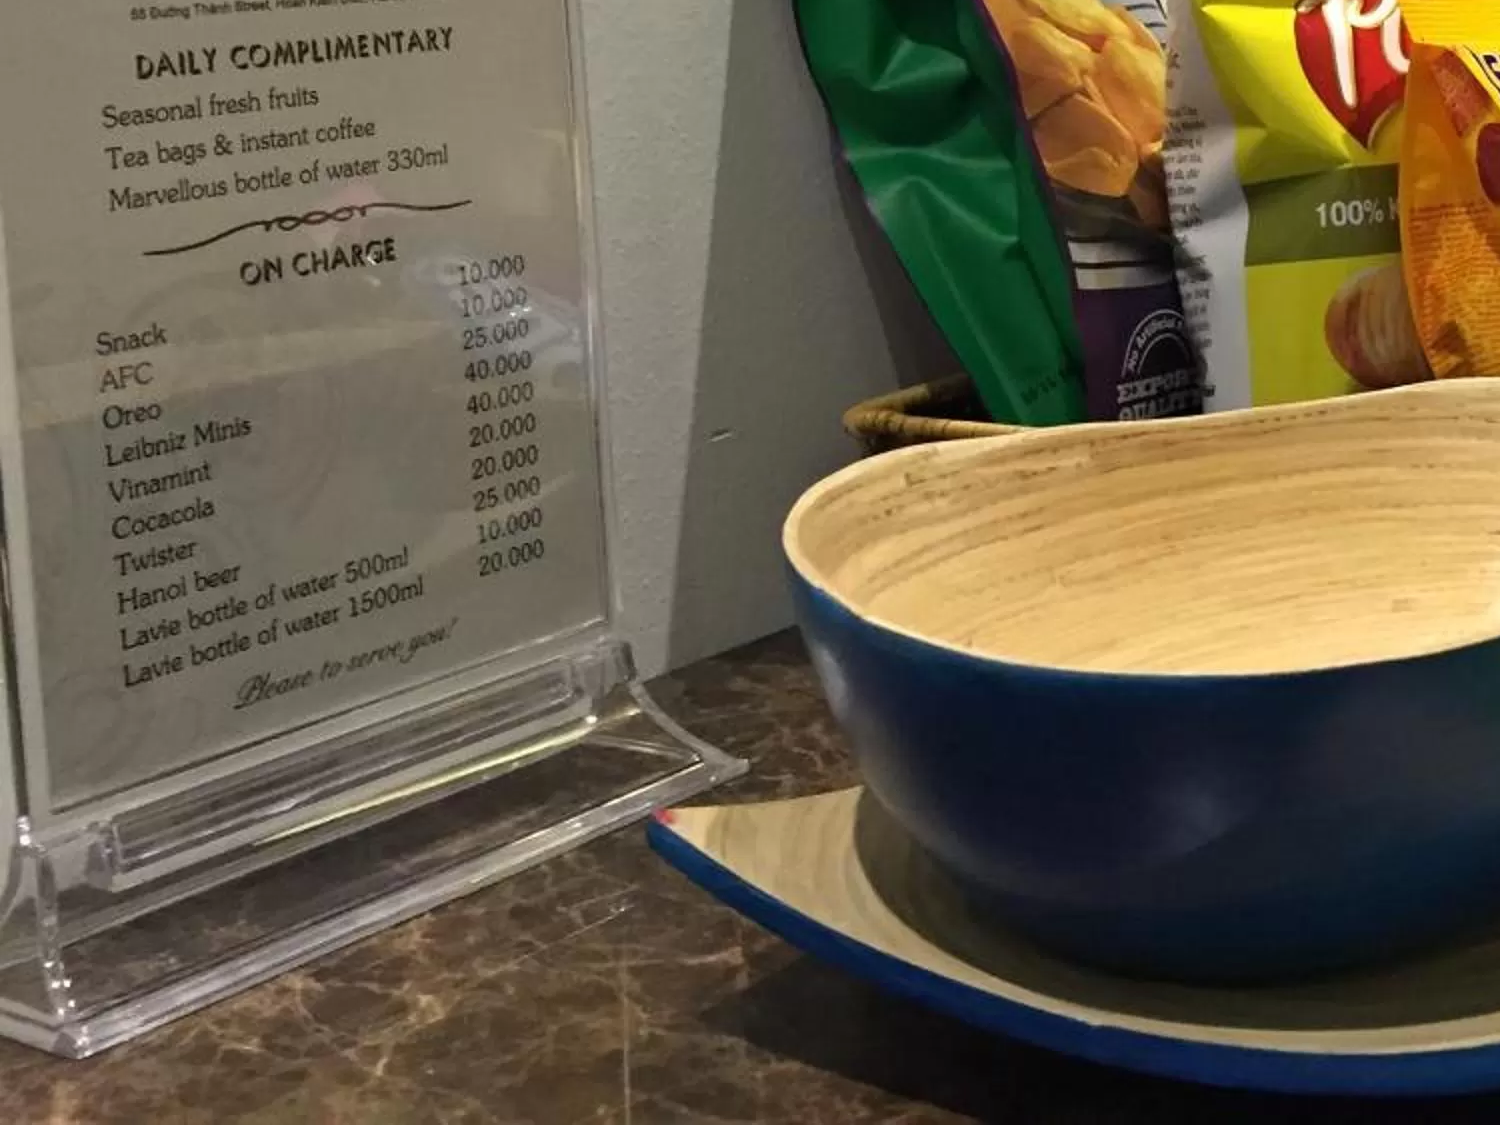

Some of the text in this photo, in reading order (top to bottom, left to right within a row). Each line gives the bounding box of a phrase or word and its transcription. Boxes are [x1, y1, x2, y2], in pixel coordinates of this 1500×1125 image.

[135, 27, 453, 80] DAILY COMPLIMENTARY
[101, 86, 319, 128] Seasonal fresh fruits
[105, 118, 376, 169] Tea bags & instant coffee
[108, 144, 449, 211] Marvellous bottle of water 330ml
[1315, 197, 1385, 228] 100%
[239, 238, 396, 286] ON CHARGE
[459, 254, 525, 286] 10.000
[461, 286, 527, 317] 10.000
[96, 323, 168, 356] Snack
[463, 319, 529, 350] 25.000
[99, 361, 154, 393] AFC
[464, 350, 532, 383] 40.000
[102, 403, 162, 429] Oreo
[466, 381, 534, 415] 40.000
[105, 417, 252, 467] Leibniz Minis
[469, 412, 537, 448] 20.000
[472, 444, 539, 480] 20.000
[107, 460, 213, 503] Vinamint
[473, 475, 541, 512] 25.000
[111, 497, 215, 539] Cocacola
[478, 507, 543, 544] 10.000
[113, 541, 199, 576] Twister
[479, 539, 545, 577] 20.000
[117, 565, 241, 615] Hanoi beer
[120, 544, 409, 651] Lavie bottle of water 500ml
[123, 576, 424, 688] Lavie bottle of water 1500ml
[233, 616, 459, 710] Please to serve you!
